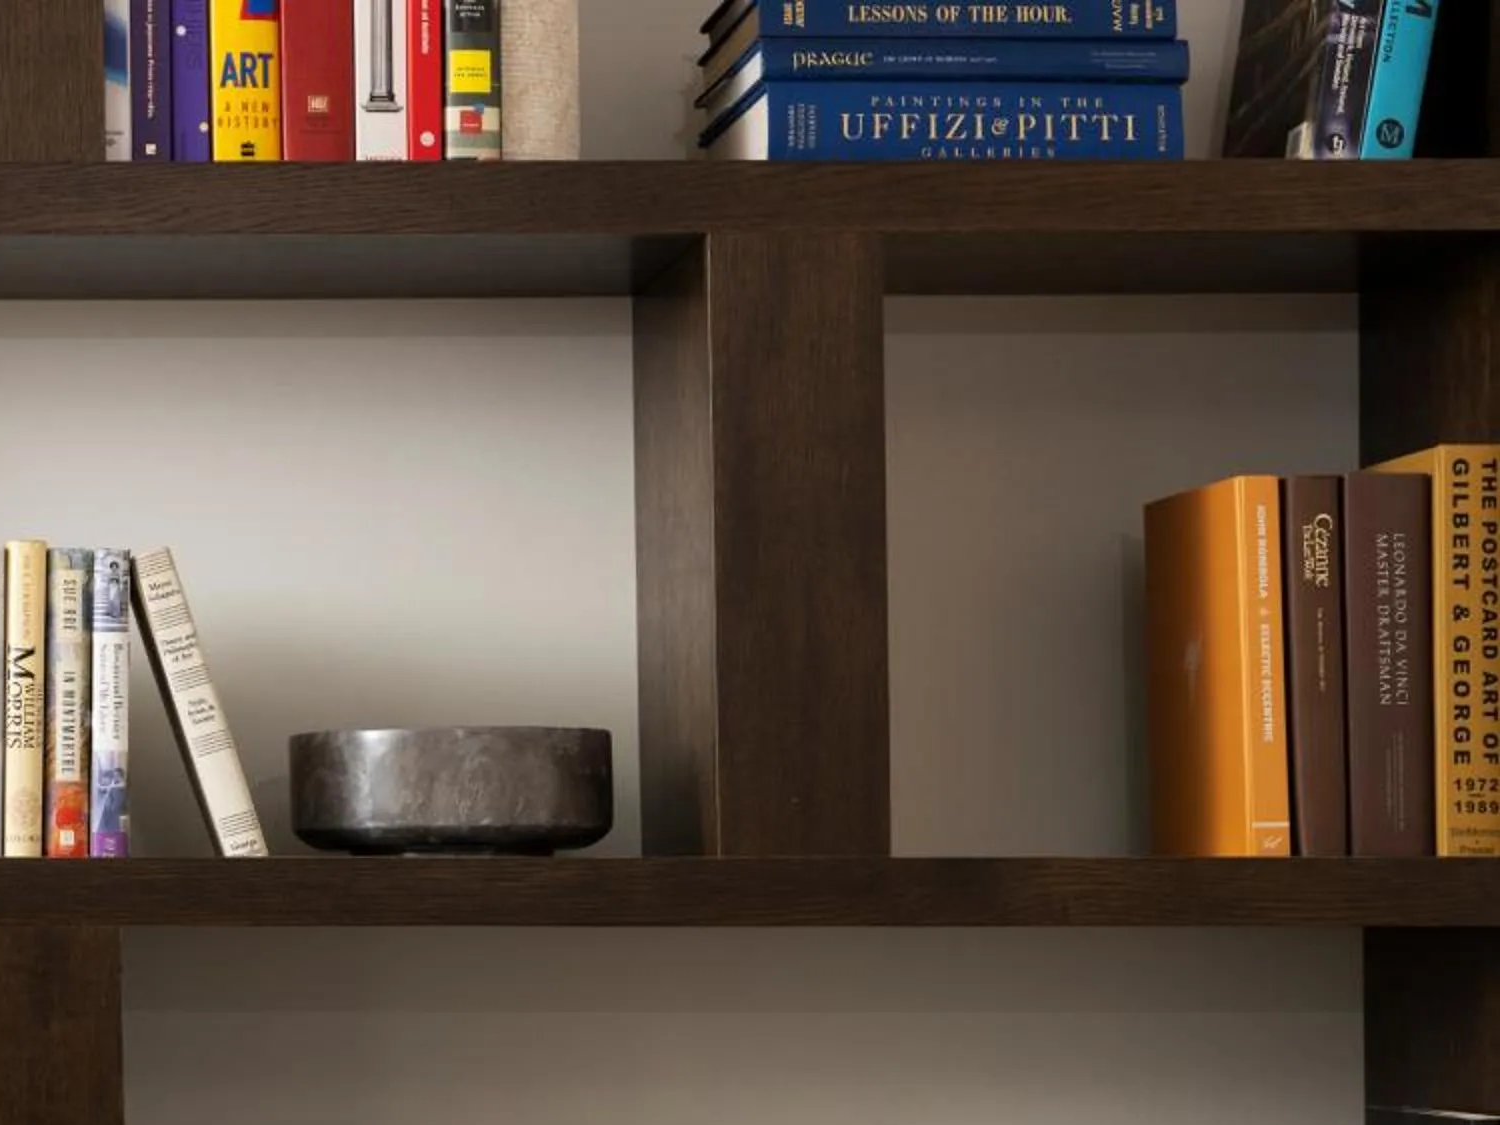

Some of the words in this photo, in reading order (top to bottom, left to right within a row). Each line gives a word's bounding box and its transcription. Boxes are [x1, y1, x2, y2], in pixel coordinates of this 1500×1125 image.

[847, 5, 928, 23] LESSONS
[935, 5, 961, 23] OF
[967, 5, 1008, 23] THE
[1016, 4, 1073, 23] HOUR.
[220, 51, 274, 89] ART
[238, 102, 272, 113] NEW
[870, 96, 1001, 107] PAINTINGS
[1019, 96, 1042, 108] IN
[1060, 97, 1103, 108] THE
[217, 115, 280, 128] HISTORY
[840, 112, 985, 140] UFFIZI
[990, 117, 1009, 136] &
[1017, 113, 1136, 141] PITTI
[921, 147, 1055, 158] GALLERIES
[1481, 461, 1498, 509] THE
[1453, 458, 1470, 590] GILBERT
[1376, 534, 1390, 598] MASTER
[1392, 533, 1407, 624] LEONARDO
[63, 579, 77, 604] SUE
[1481, 521, 1498, 660] POSTCARD
[63, 609, 77, 631] ROE
[1453, 604, 1469, 622] &
[1378, 605, 1391, 706] DRAFTSMAN
[1395, 630, 1407, 652] DA
[62, 671, 76, 684] IN
[1395, 659, 1409, 706] VINCI
[1453, 635, 1471, 766] GEORGE
[1482, 671, 1498, 719] ART
[23, 683, 35, 749] WILLIAM
[61, 690, 77, 773] MONTMARTRE
[1483, 732, 1498, 766] OF
[1453, 778, 1499, 791] 1972
[1453, 801, 1499, 814] 1989
